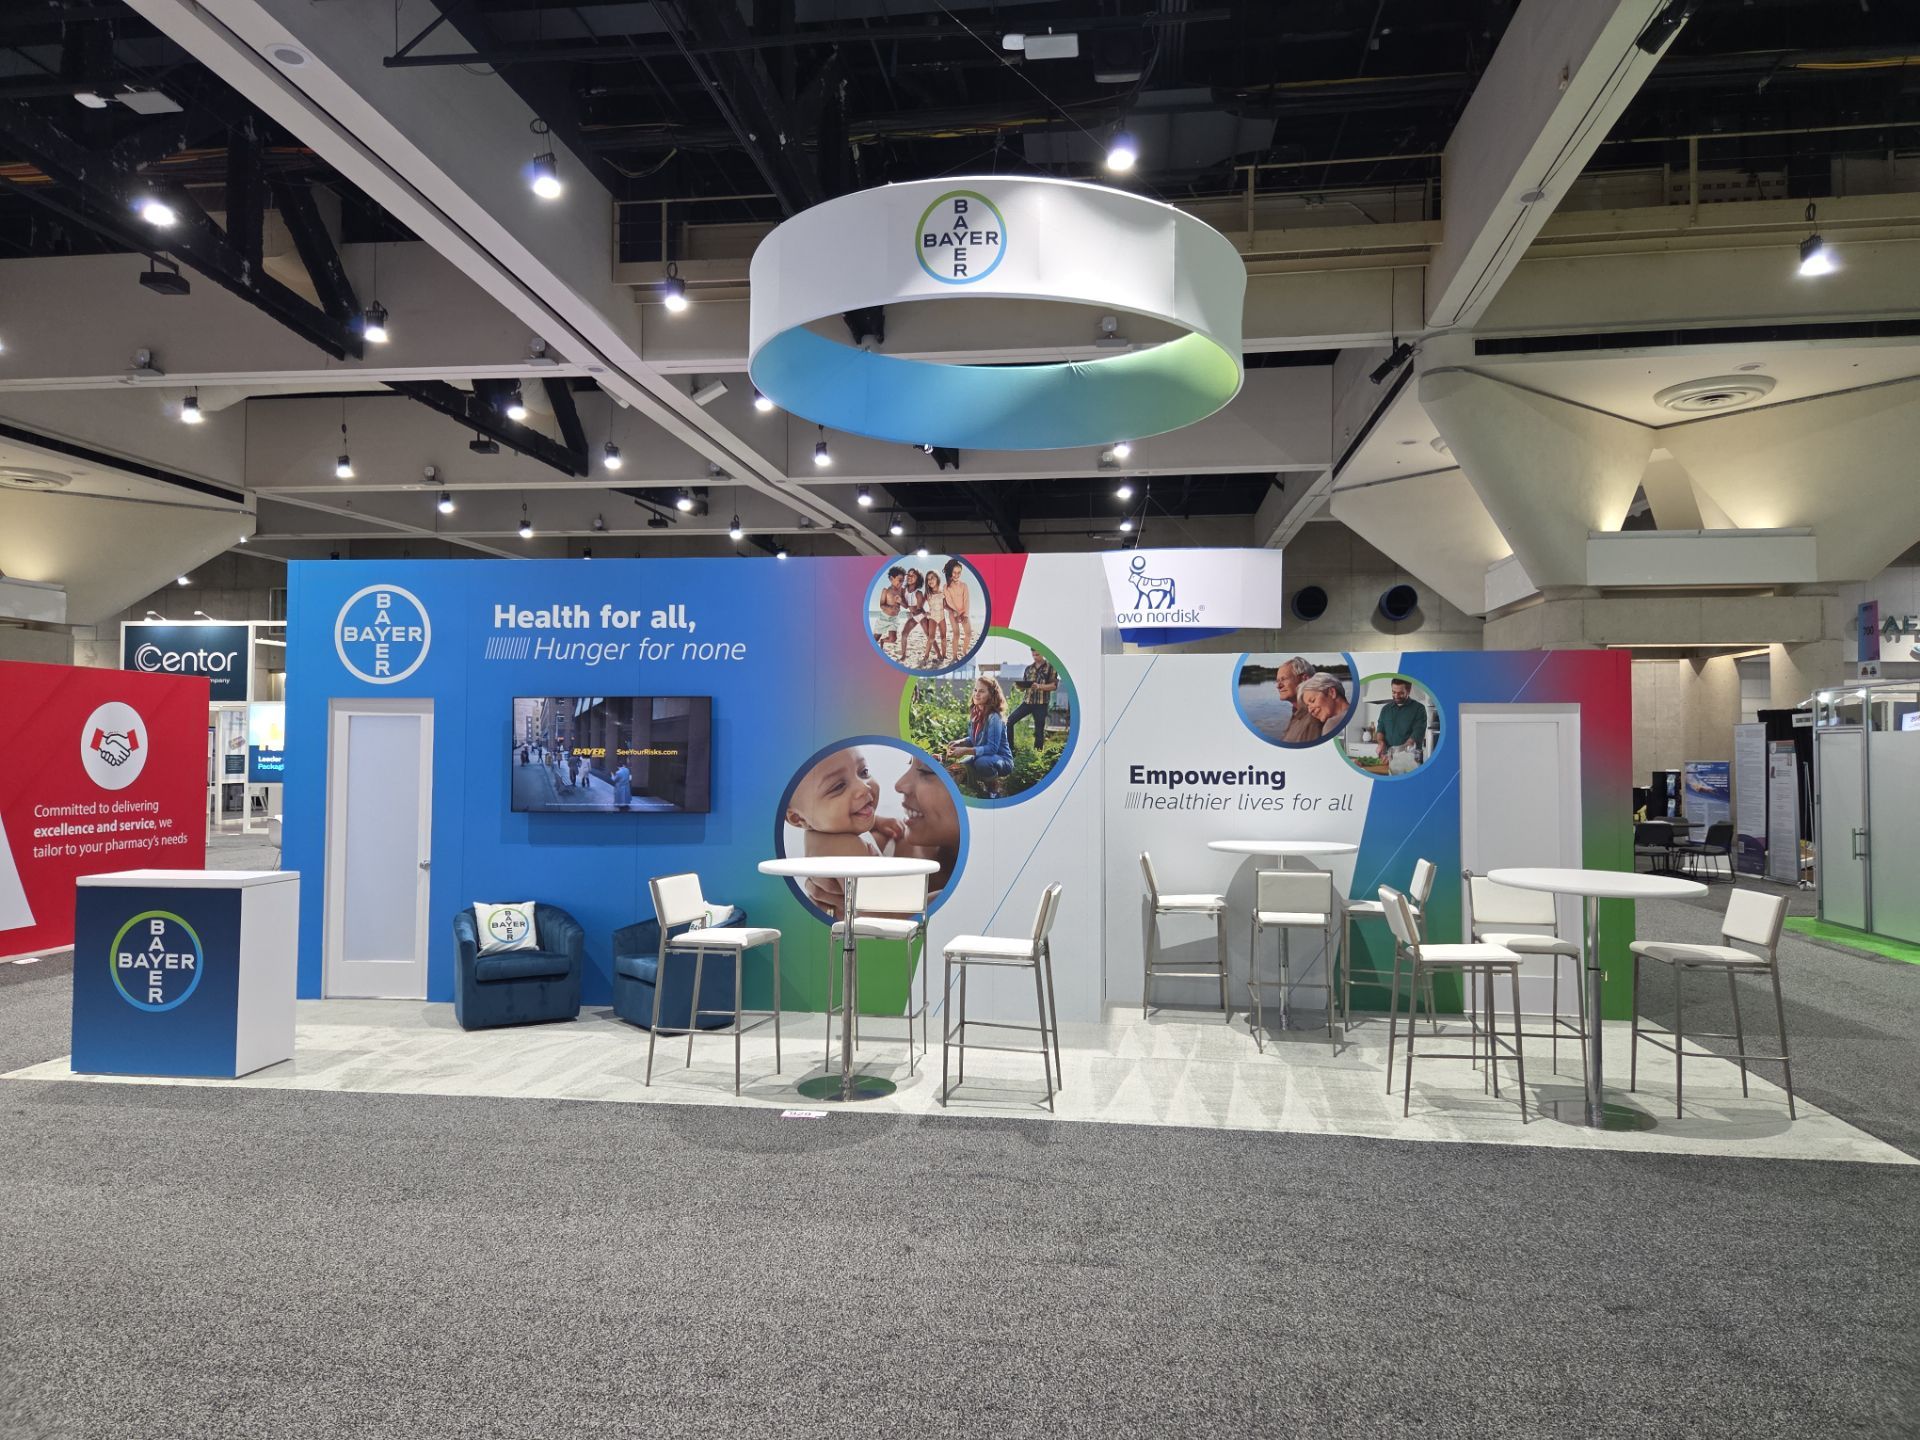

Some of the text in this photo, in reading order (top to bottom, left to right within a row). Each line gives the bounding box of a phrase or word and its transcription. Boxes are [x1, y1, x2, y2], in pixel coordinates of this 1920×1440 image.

[923, 231, 998, 248] BAYER
[953, 199, 968, 277] BAYER
[494, 604, 697, 633] Health for all,
[1117, 612, 1142, 623] ovo
[343, 626, 423, 642] BAYER
[375, 593, 391, 675] BAYER
[134, 642, 238, 672] Centor
[534, 637, 746, 666] Hunger for none
[573, 747, 678, 757] BAYER SeeYourRisks.com
[258, 763, 285, 771] Packag
[1129, 764, 1286, 790] Empowering
[34, 799, 159, 818] Committed to delivering
[1142, 792, 1353, 812] healthier lives for all
[33, 817, 173, 838] excellence and service, we
[33, 843, 63, 858] tailor
[65, 843, 77, 856] to
[79, 841, 105, 857] your
[161, 832, 188, 846] needs
[505, 911, 514, 940] BAYER
[118, 952, 195, 969] BAYER
[148, 919, 165, 1003] BAYER
